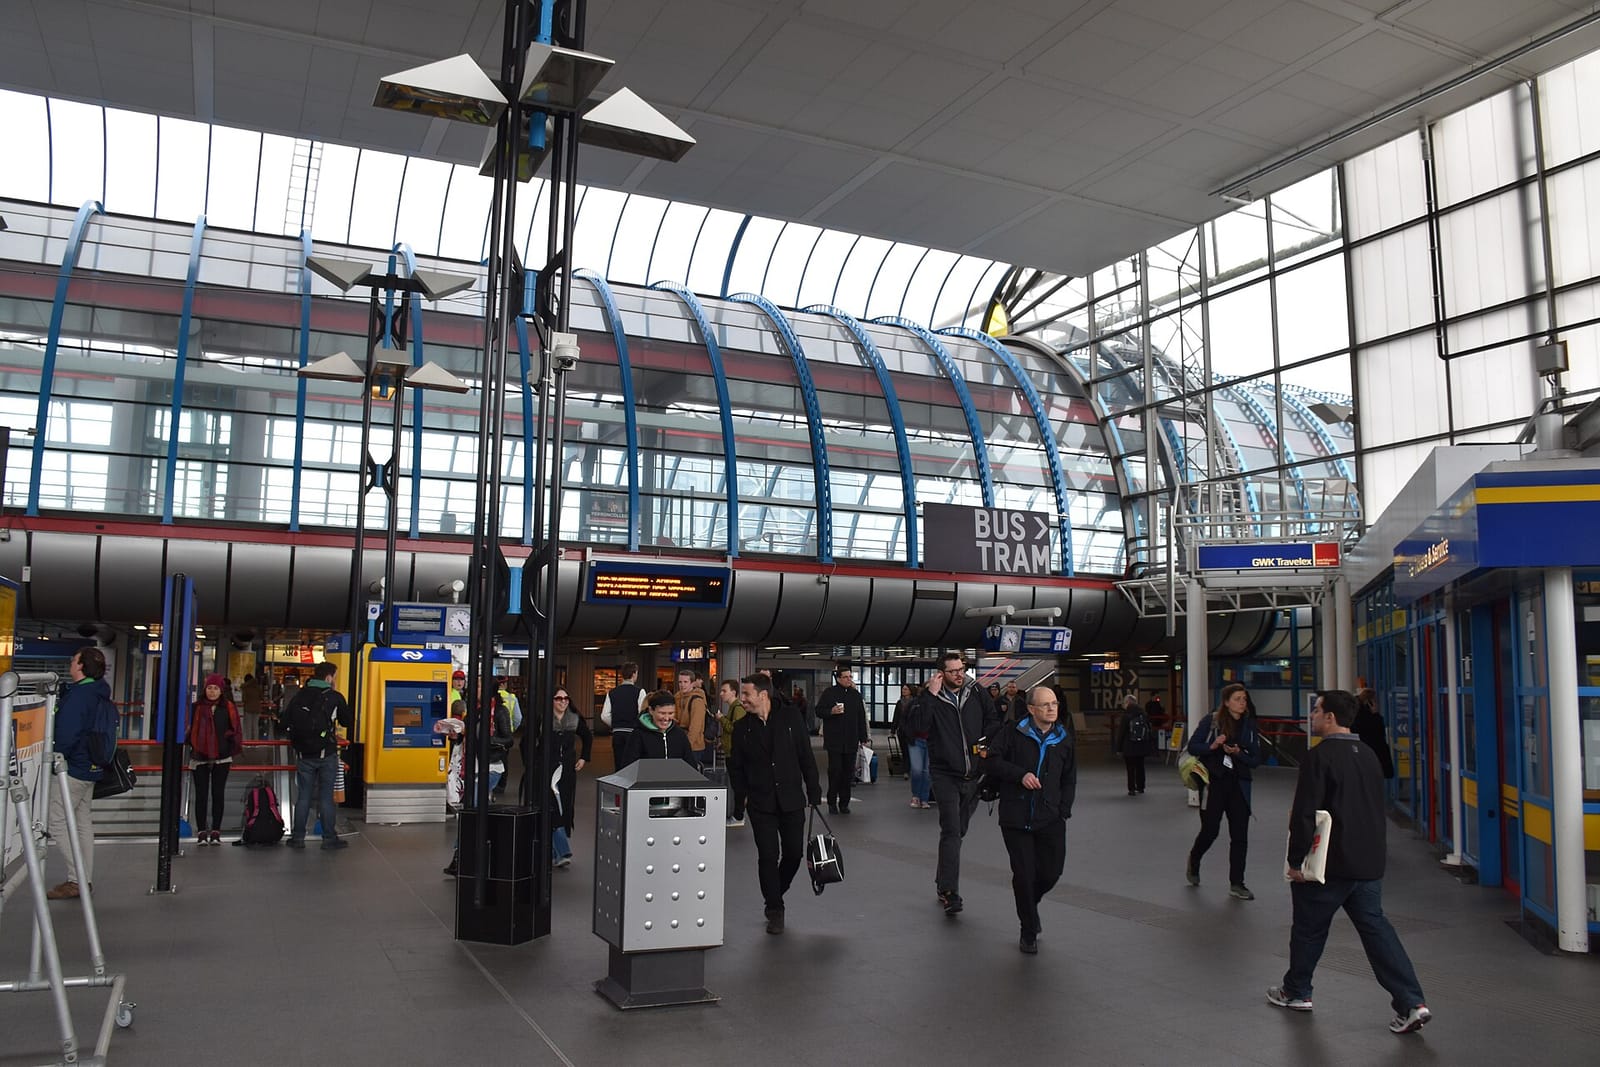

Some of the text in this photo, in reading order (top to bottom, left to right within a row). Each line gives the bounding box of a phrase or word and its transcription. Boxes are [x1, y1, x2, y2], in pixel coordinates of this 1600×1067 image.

[974, 509, 1026, 541] BUS
[975, 540, 1051, 575] TRAM
[1251, 557, 1276, 567] GWK
[1275, 556, 1313, 567] Travelex
[1431, 536, 1449, 563] Service
[1090, 669, 1124, 688] BUS
